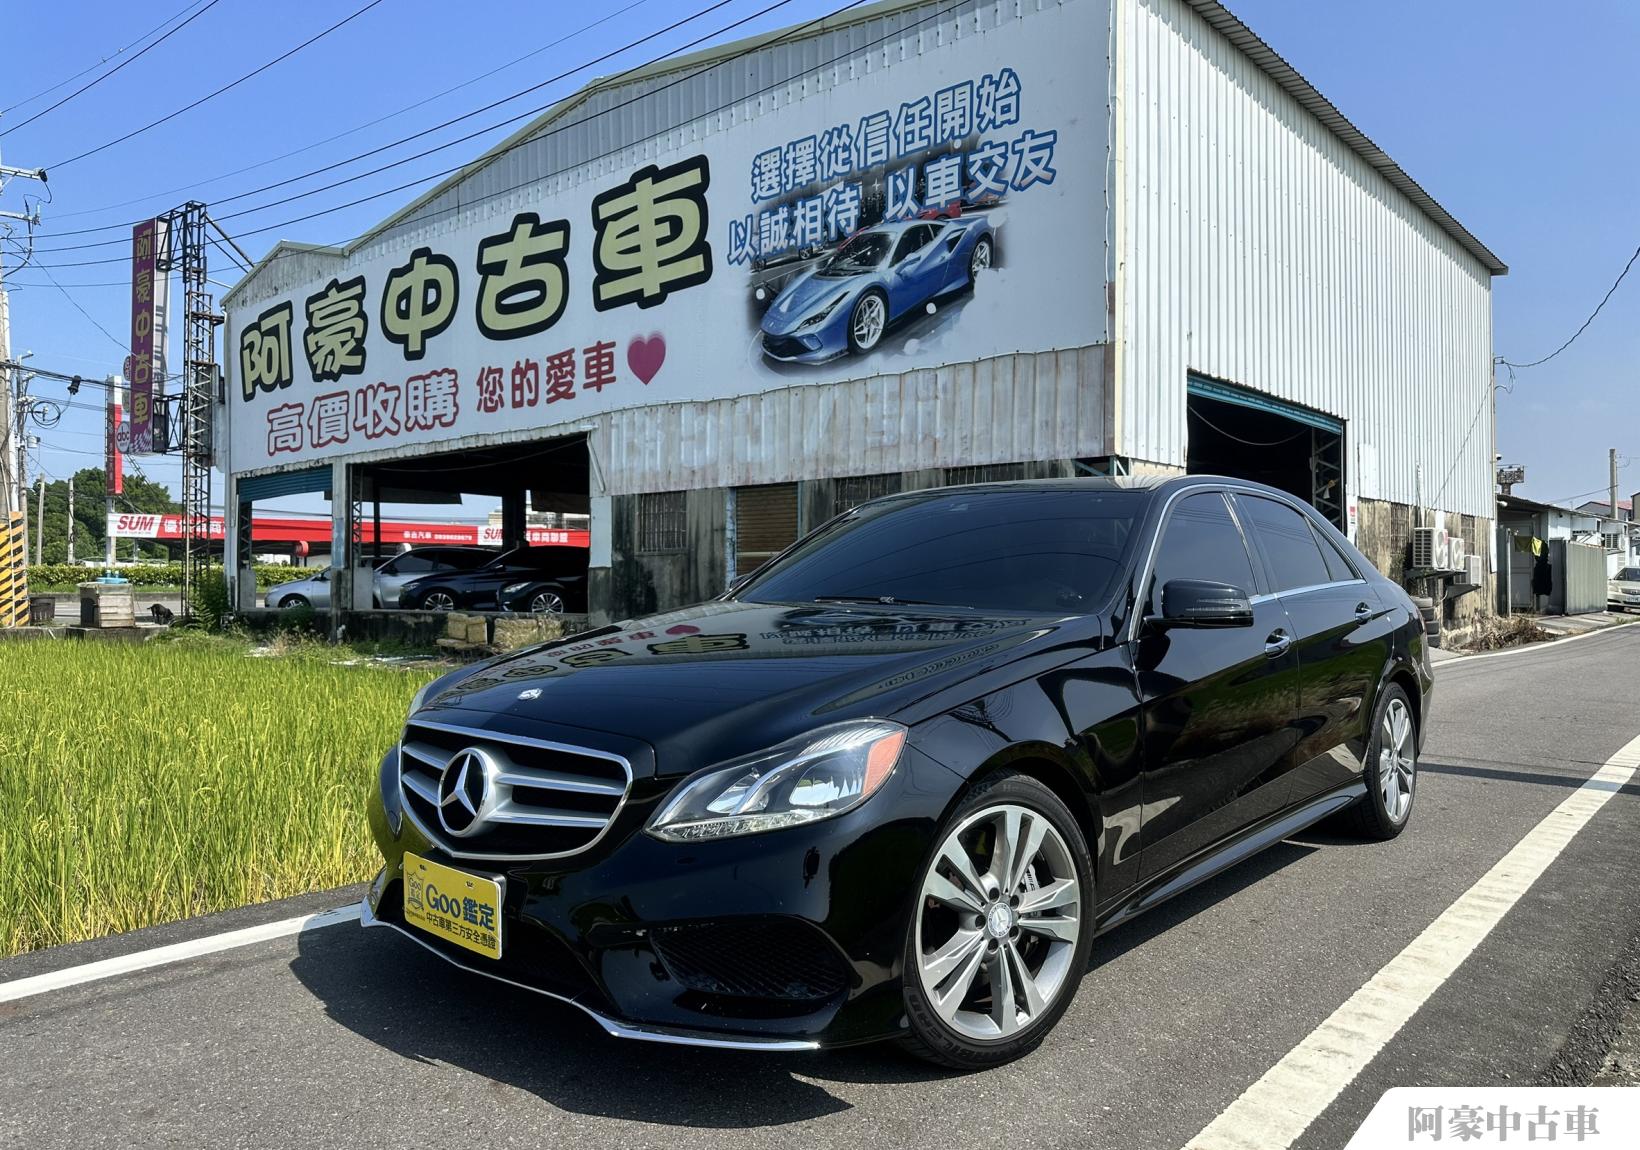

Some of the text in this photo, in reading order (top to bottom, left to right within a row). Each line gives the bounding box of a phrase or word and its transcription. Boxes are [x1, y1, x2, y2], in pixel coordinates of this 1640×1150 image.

[727, 130, 1057, 266] 以誠相待 以車交友
[751, 68, 1021, 203] 選擇從信任開始
[134, 228, 153, 424] 阿豪中古車
[240, 154, 712, 402] 阿豪中古車
[266, 341, 617, 456] 高價收購 您的愛車
[117, 516, 154, 531] SUM
